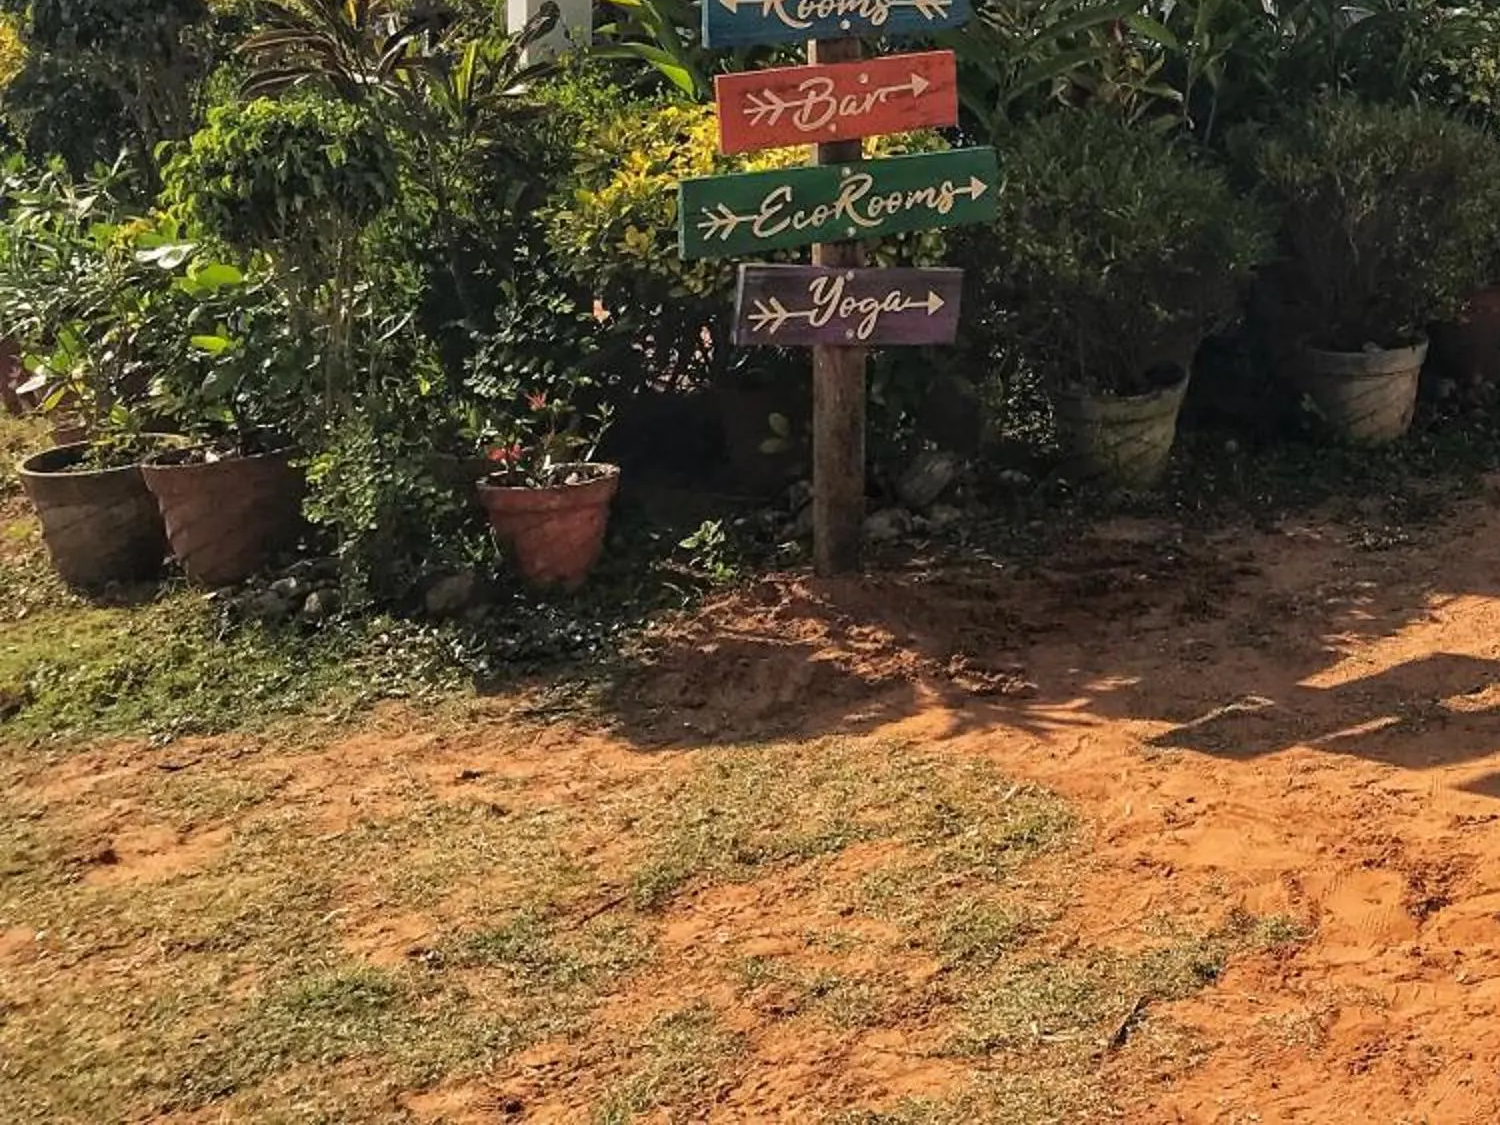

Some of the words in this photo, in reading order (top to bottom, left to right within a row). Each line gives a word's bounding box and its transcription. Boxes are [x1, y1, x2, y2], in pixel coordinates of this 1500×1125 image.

[792, 77, 889, 131] Bar
[752, 174, 956, 238] EcoRooms
[808, 275, 911, 341] Yoga
